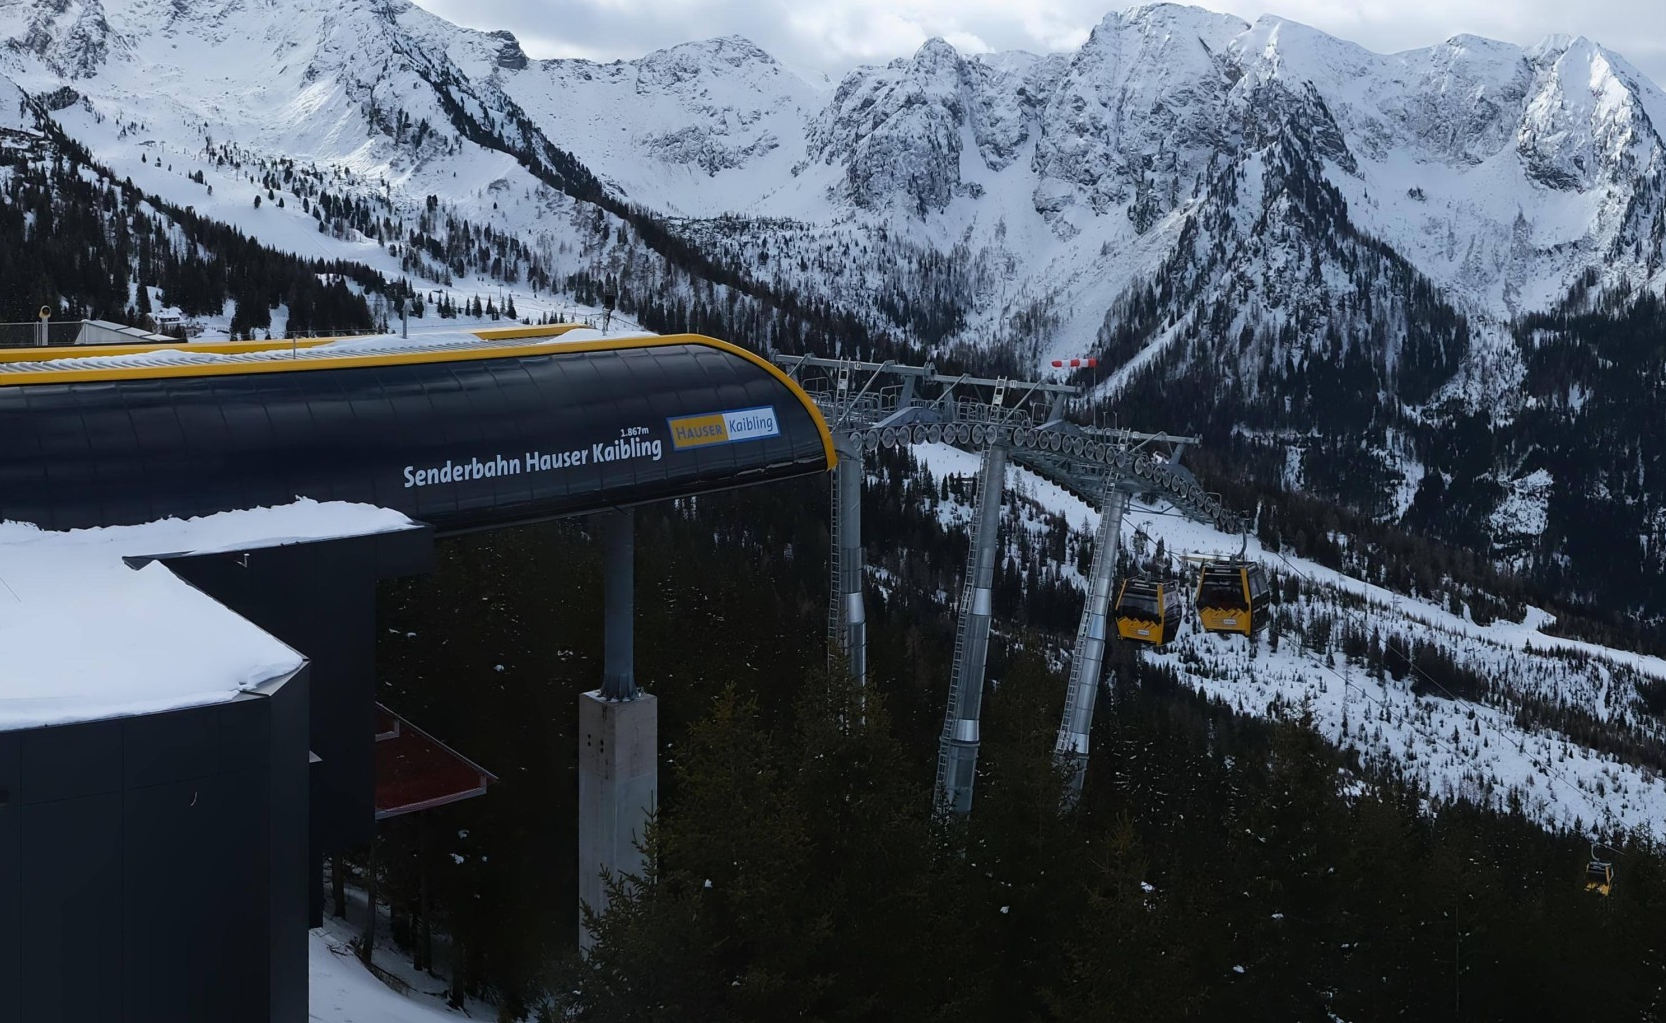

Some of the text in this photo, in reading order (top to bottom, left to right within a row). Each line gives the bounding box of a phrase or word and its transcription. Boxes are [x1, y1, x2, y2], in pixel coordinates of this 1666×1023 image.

[620, 427, 649, 437] 1.867m
[676, 416, 774, 440] HAUSER Kaibling
[403, 437, 662, 488] Senderbahn Hauser Kaibling
